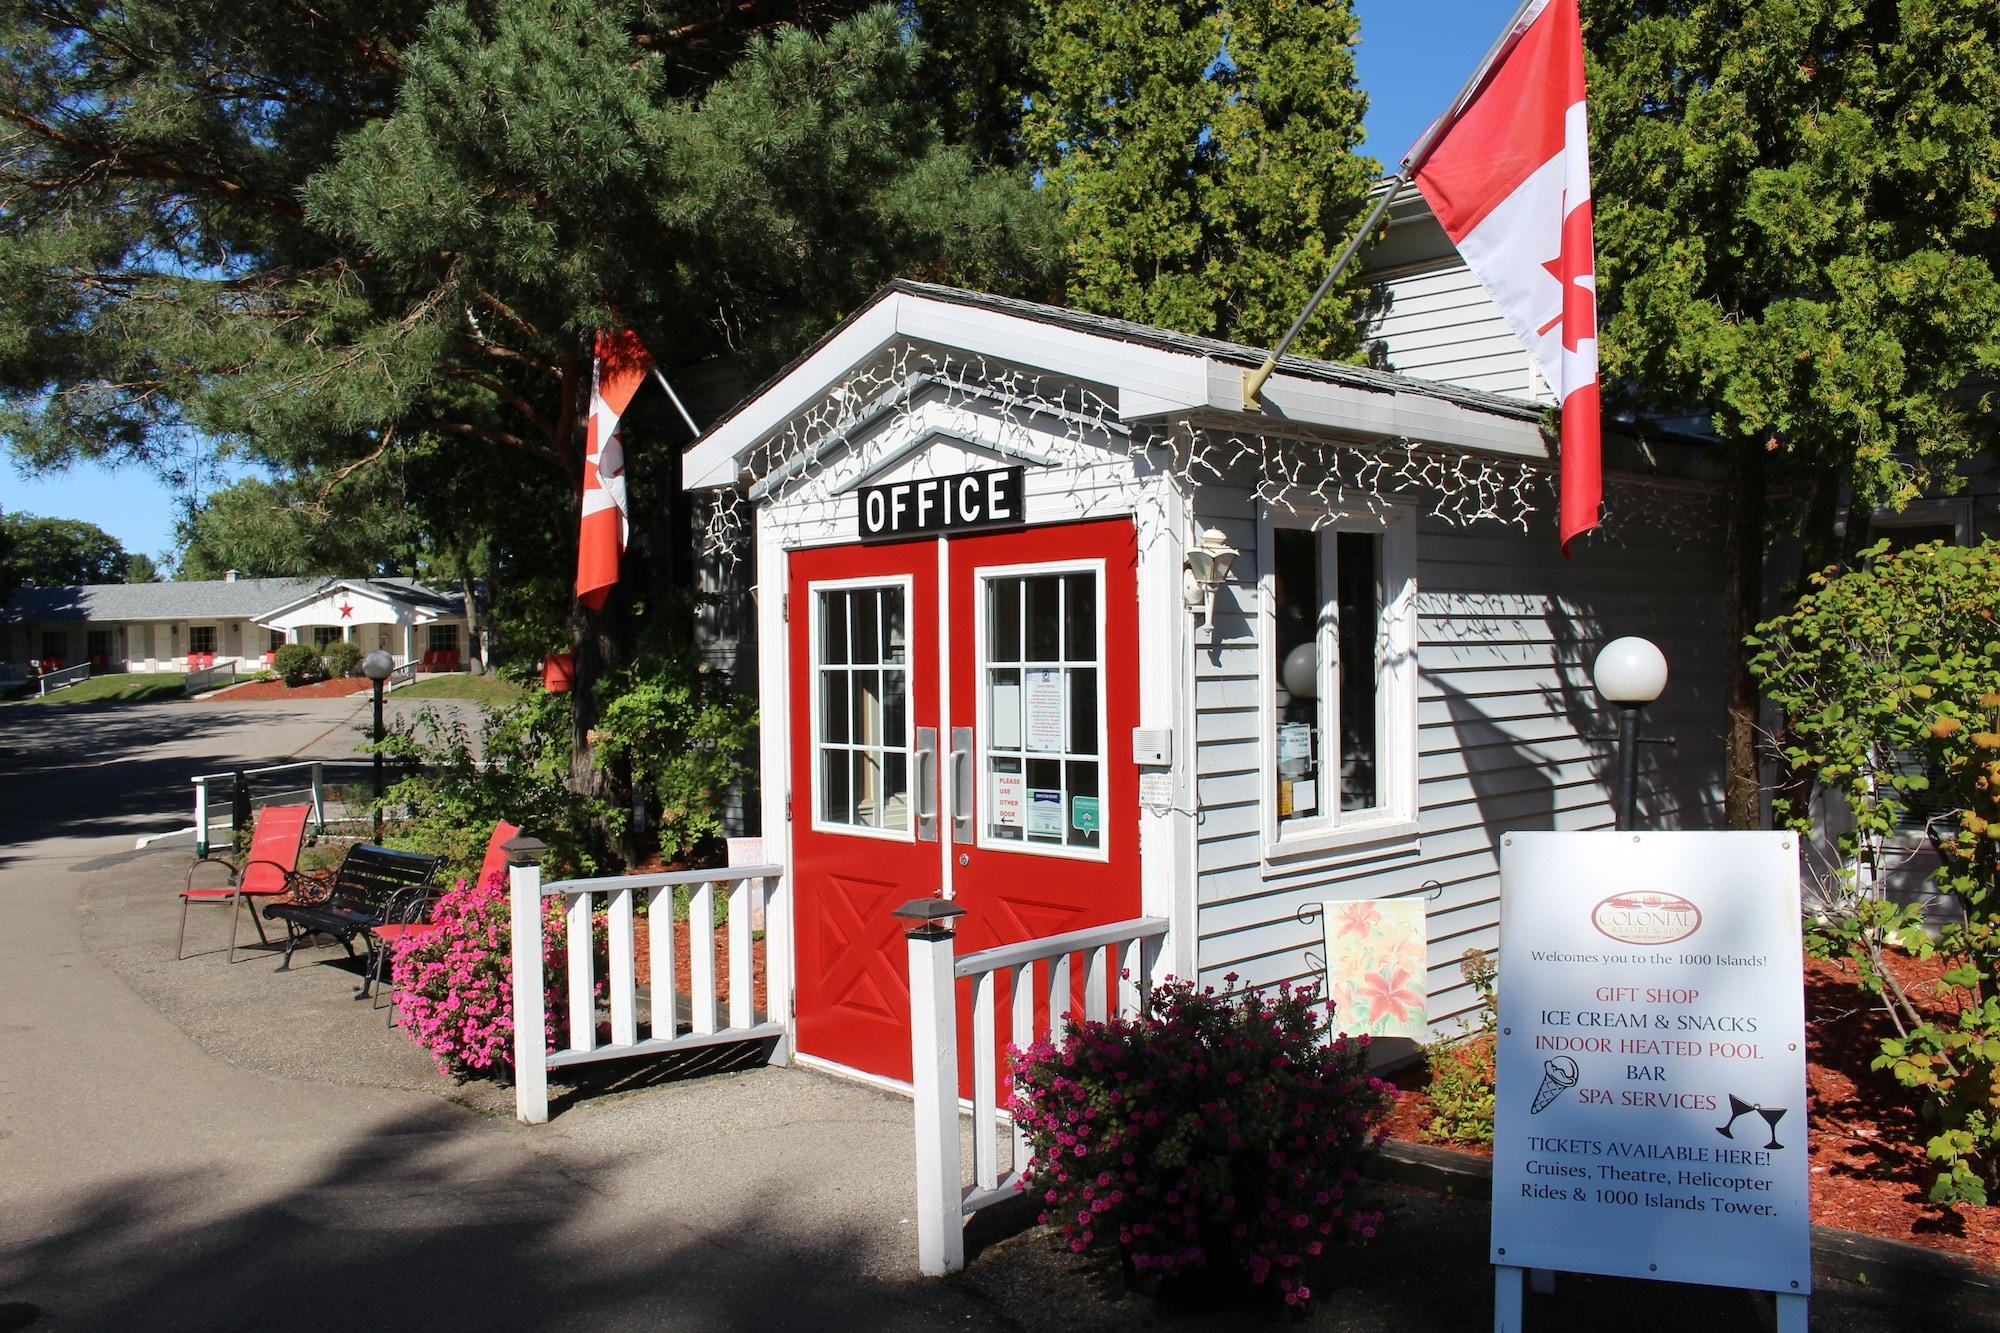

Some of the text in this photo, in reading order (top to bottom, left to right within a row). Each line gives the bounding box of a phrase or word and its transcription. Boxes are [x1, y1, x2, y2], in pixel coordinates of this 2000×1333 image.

[866, 472, 1010, 532] OFFICE
[999, 777, 1020, 785] PLEASE
[1599, 911, 1693, 927] COLONIAL
[1531, 950, 1767, 967] Welcomes you to the 1000 Islands!
[1596, 987, 1699, 1004] GIFT SHOP
[1541, 1010, 1757, 1032] ICE CREAM & SNACKS
[1535, 1036, 1763, 1060] INDOOR HEATED POOL
[1627, 1065, 1666, 1081] BAR
[1579, 1089, 1716, 1110] SPA SERVICES
[1527, 1136, 1770, 1166] TICKETS AVAILABLE HERE!
[1526, 1160, 1772, 1192] Cruises, Theatre, Helicopter
[1521, 1184, 1777, 1217] Rides & 1000 Islands Tower.
